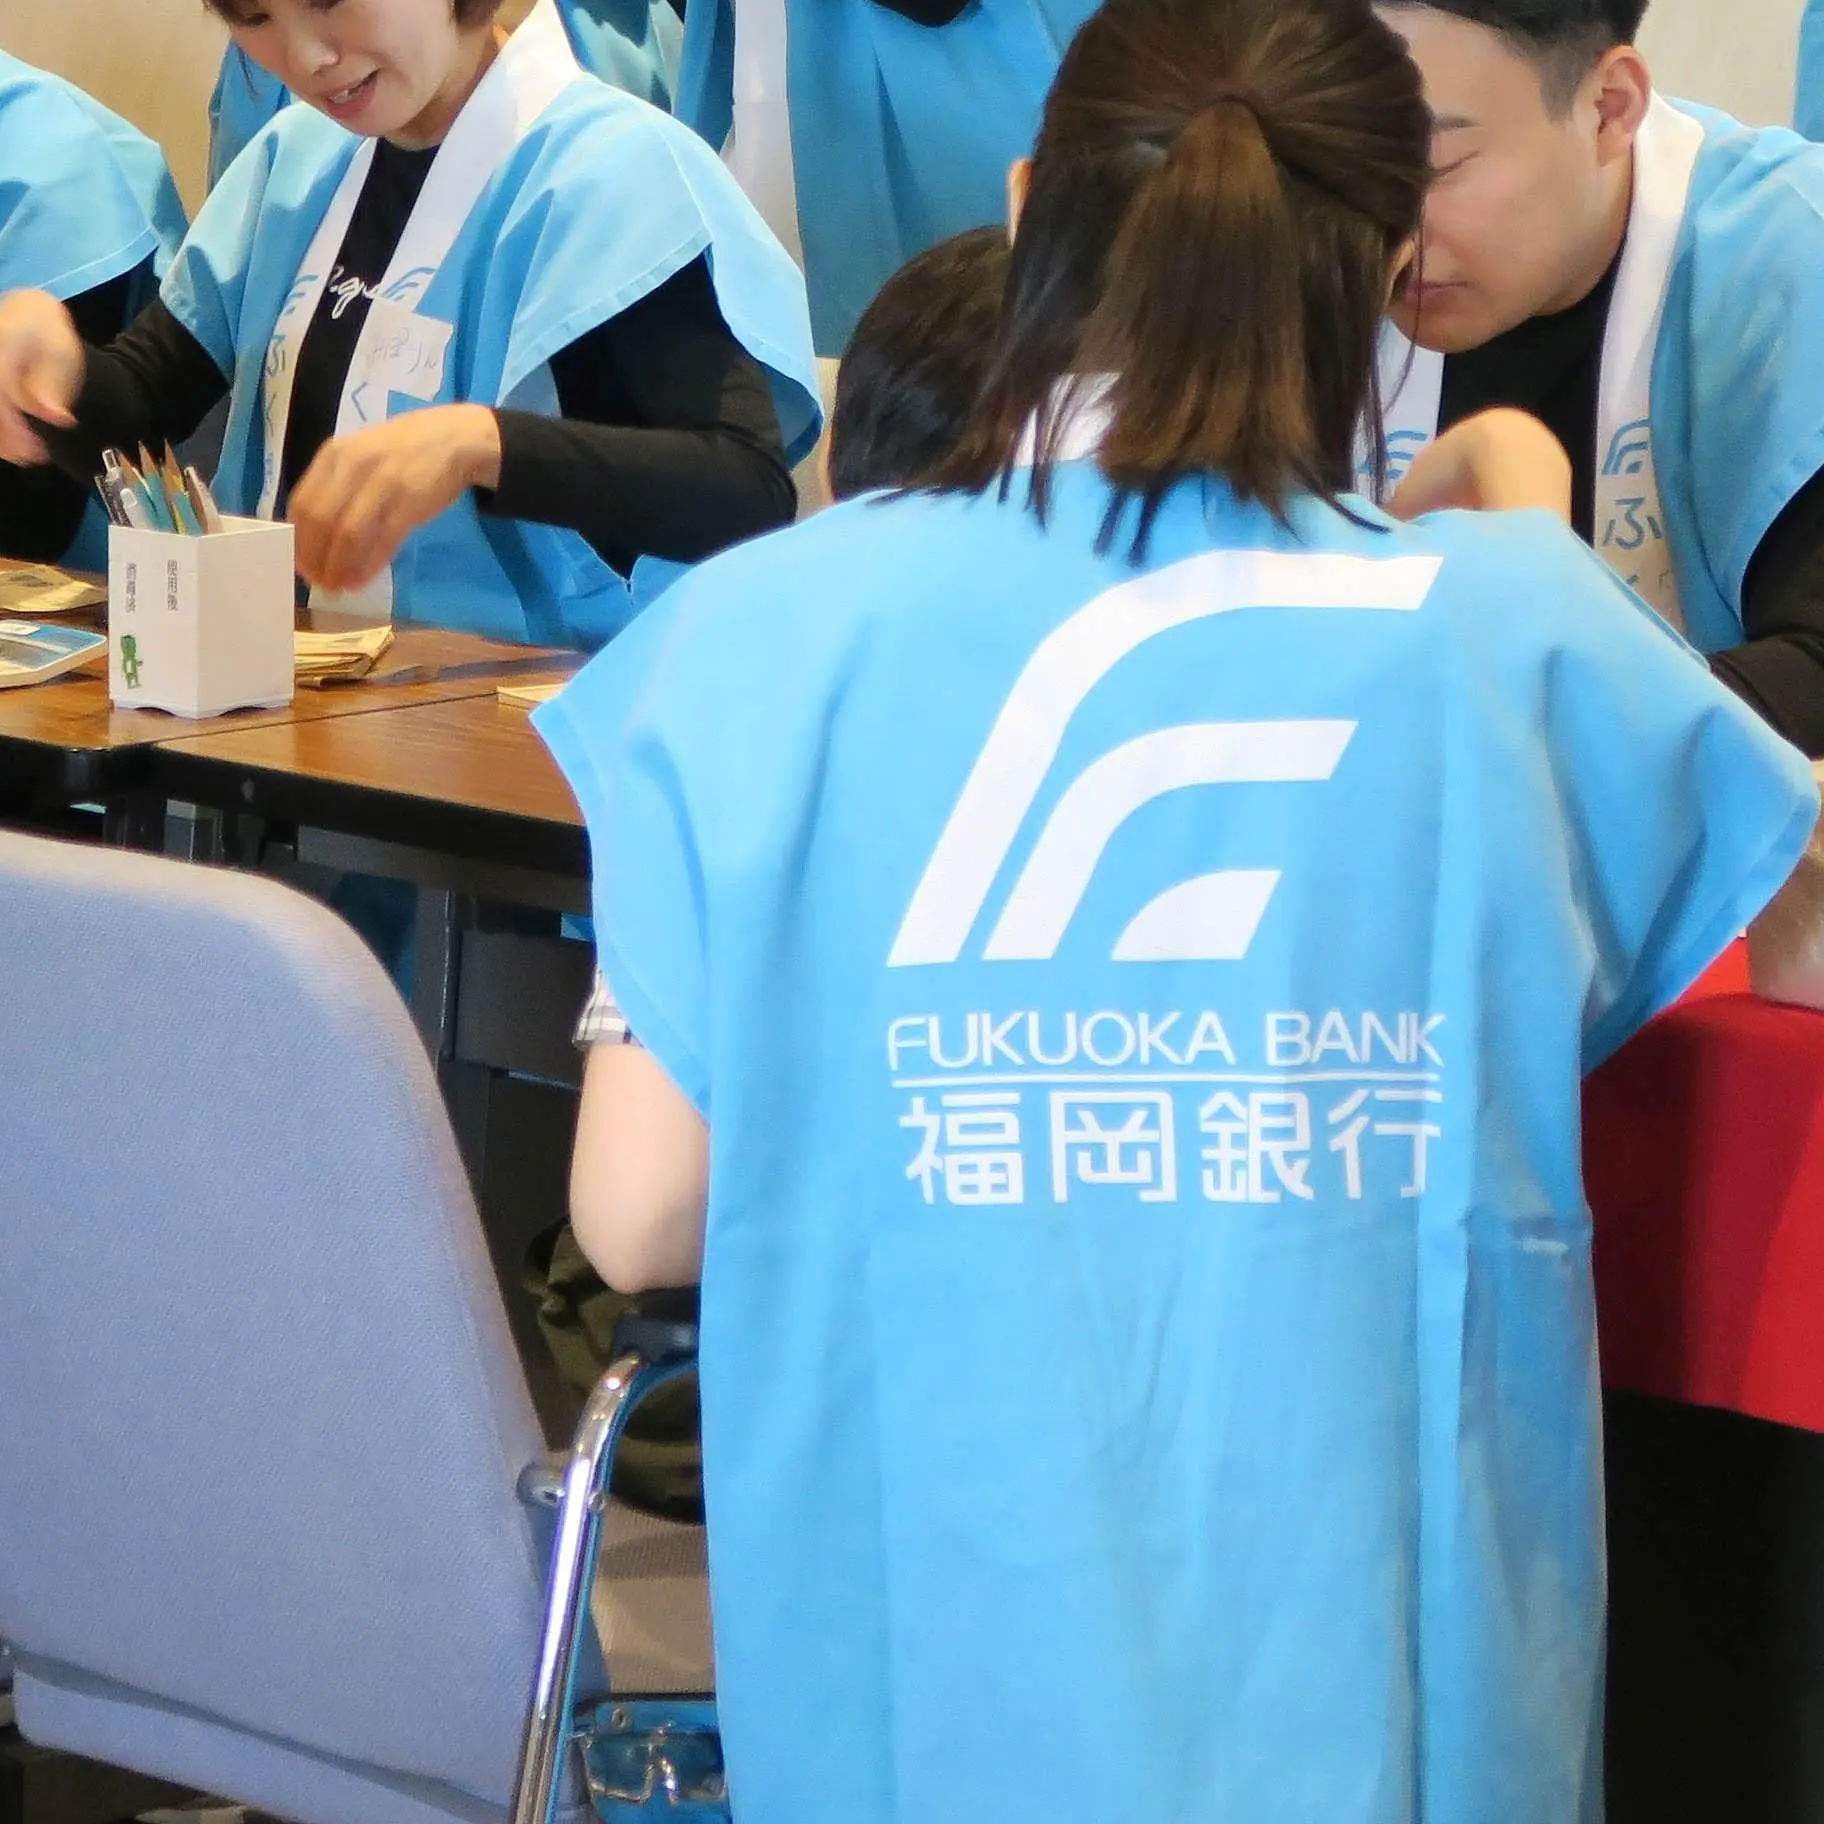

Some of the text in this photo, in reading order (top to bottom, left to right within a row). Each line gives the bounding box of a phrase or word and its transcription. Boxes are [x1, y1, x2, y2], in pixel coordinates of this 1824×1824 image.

[887, 1011, 1446, 1070] FUKUOKA BANK
[899, 1089, 1442, 1205] 福岡銀行
